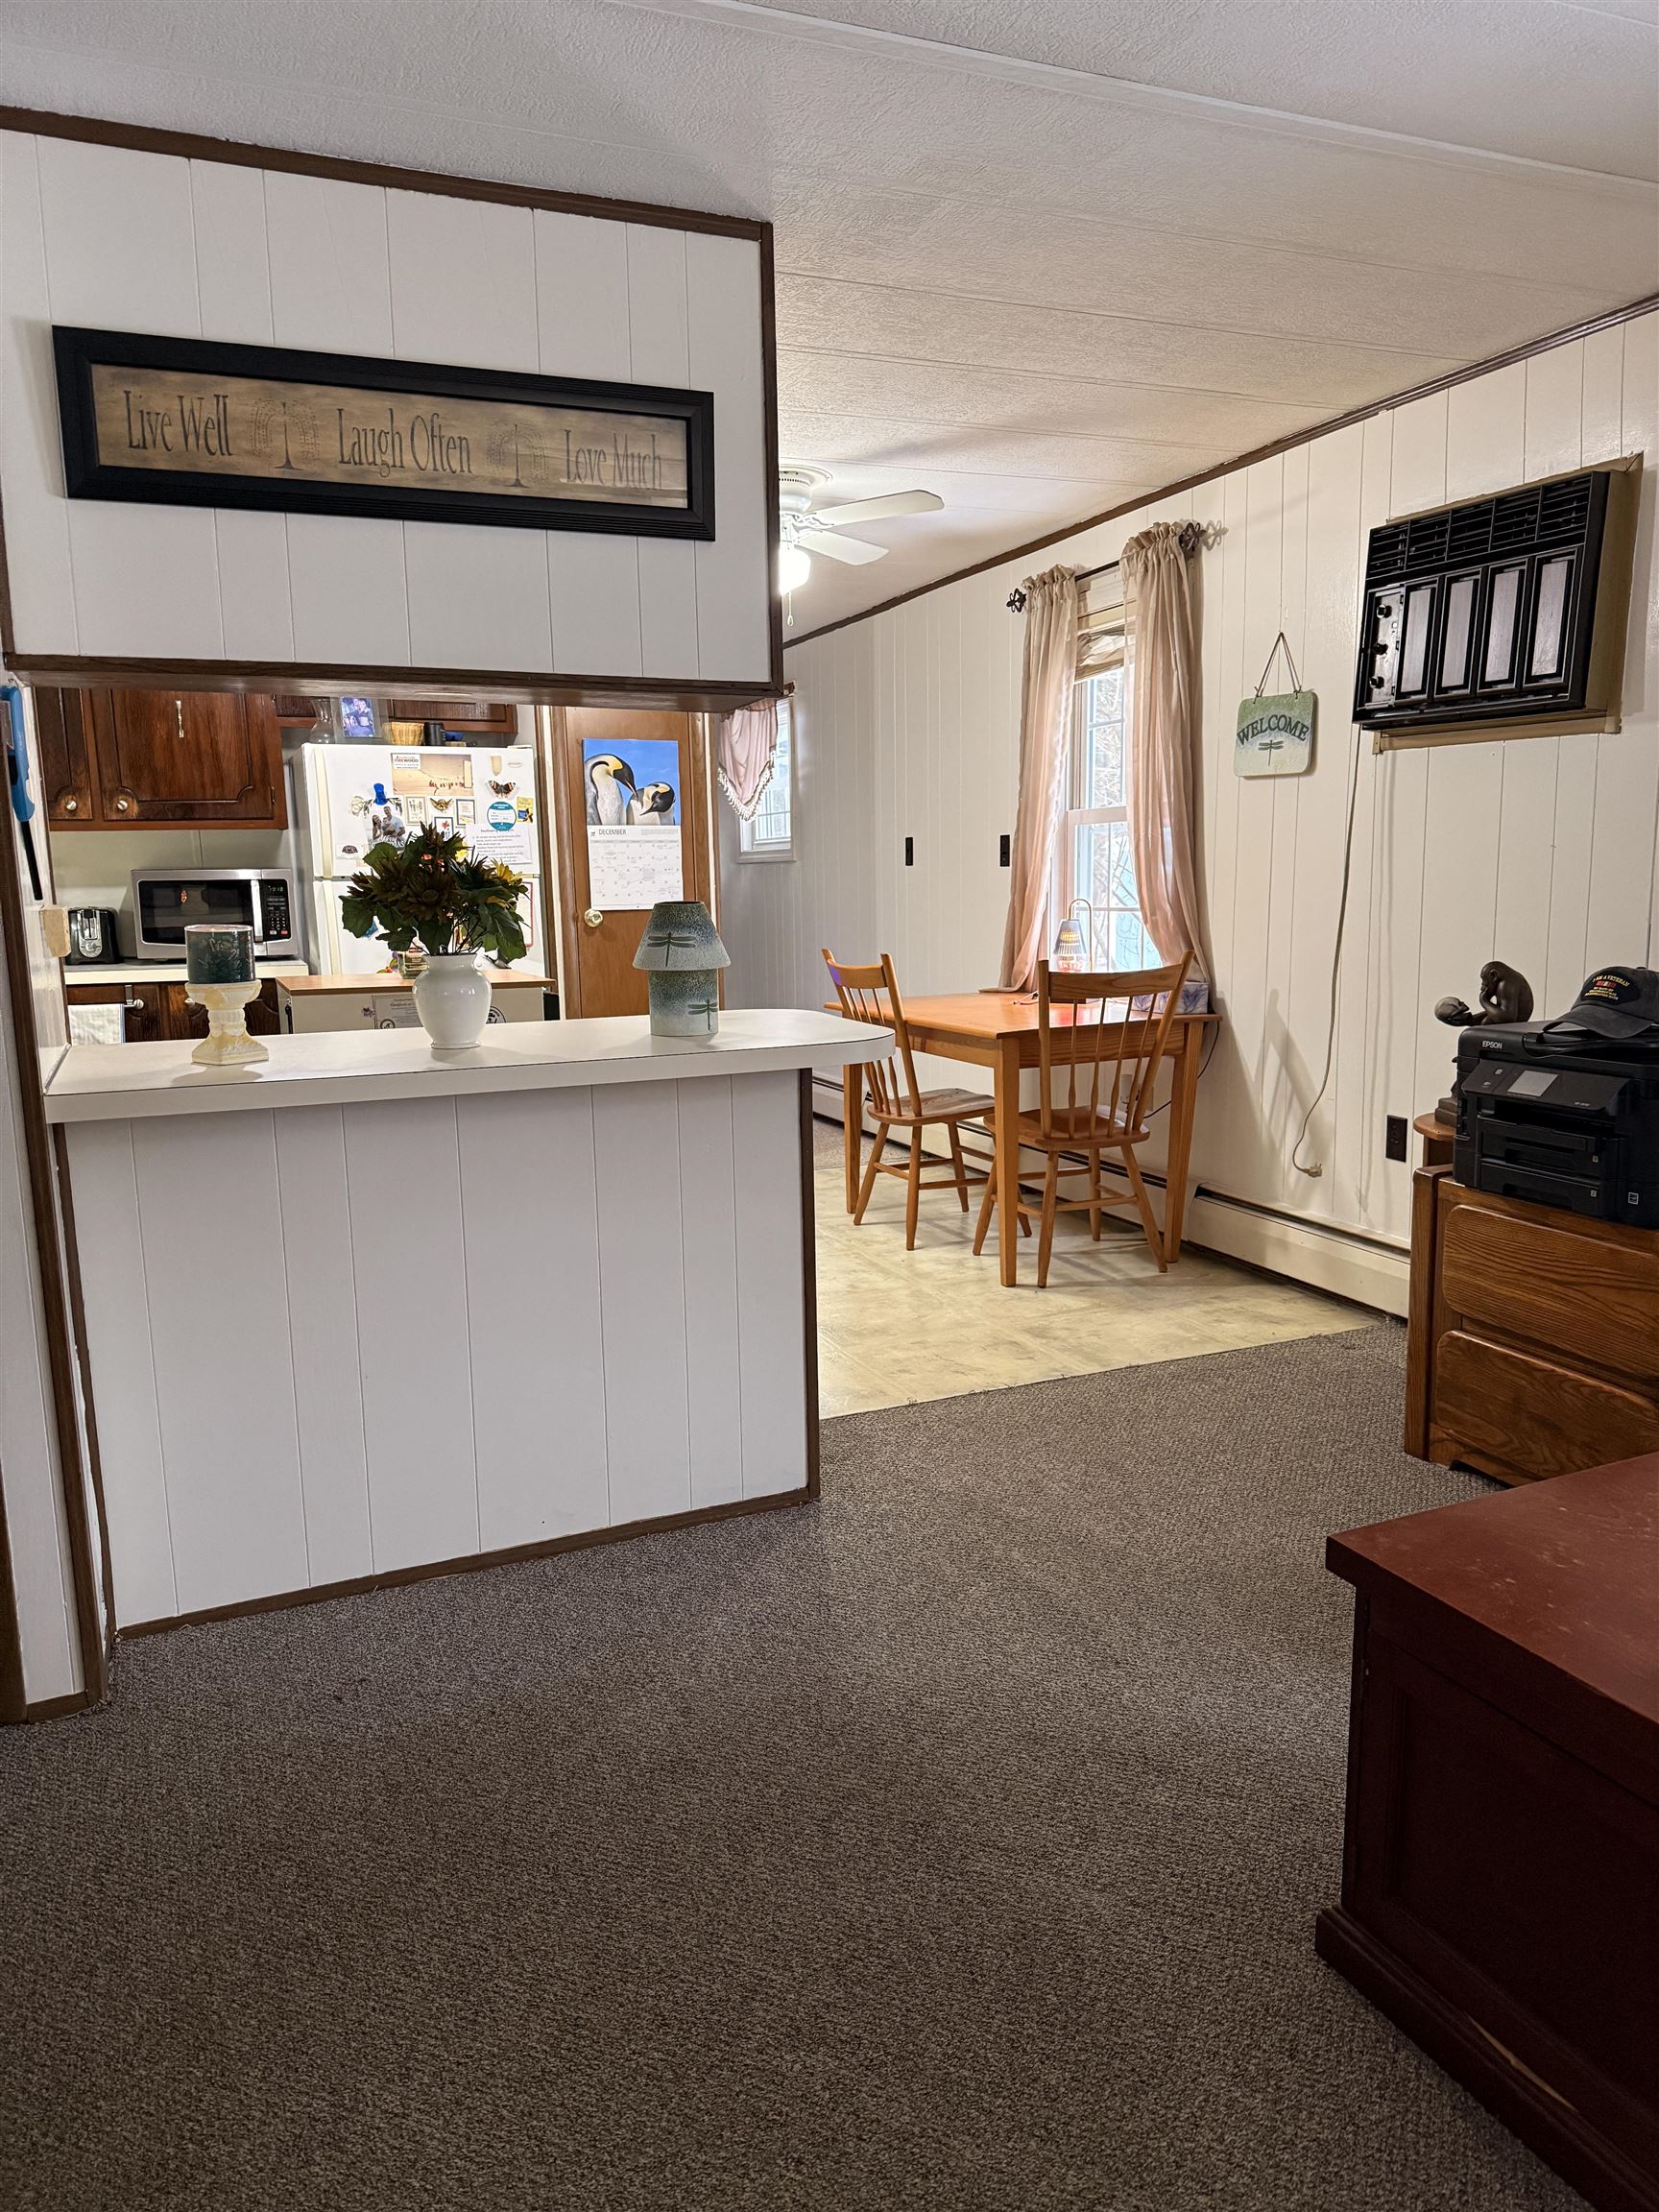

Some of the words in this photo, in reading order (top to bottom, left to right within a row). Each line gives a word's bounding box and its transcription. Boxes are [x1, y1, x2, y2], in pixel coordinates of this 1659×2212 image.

[123, 390, 173, 452] Live
[177, 394, 232, 456] Well
[337, 408, 405, 478] Laugh
[410, 412, 472, 474] Often
[564, 429, 607, 486] Love
[613, 432, 662, 490] Much
[1237, 714, 1310, 745] WELCOME
[1607, 974, 1630, 987] VETERAN
[1481, 1040, 1503, 1049] EPSON
